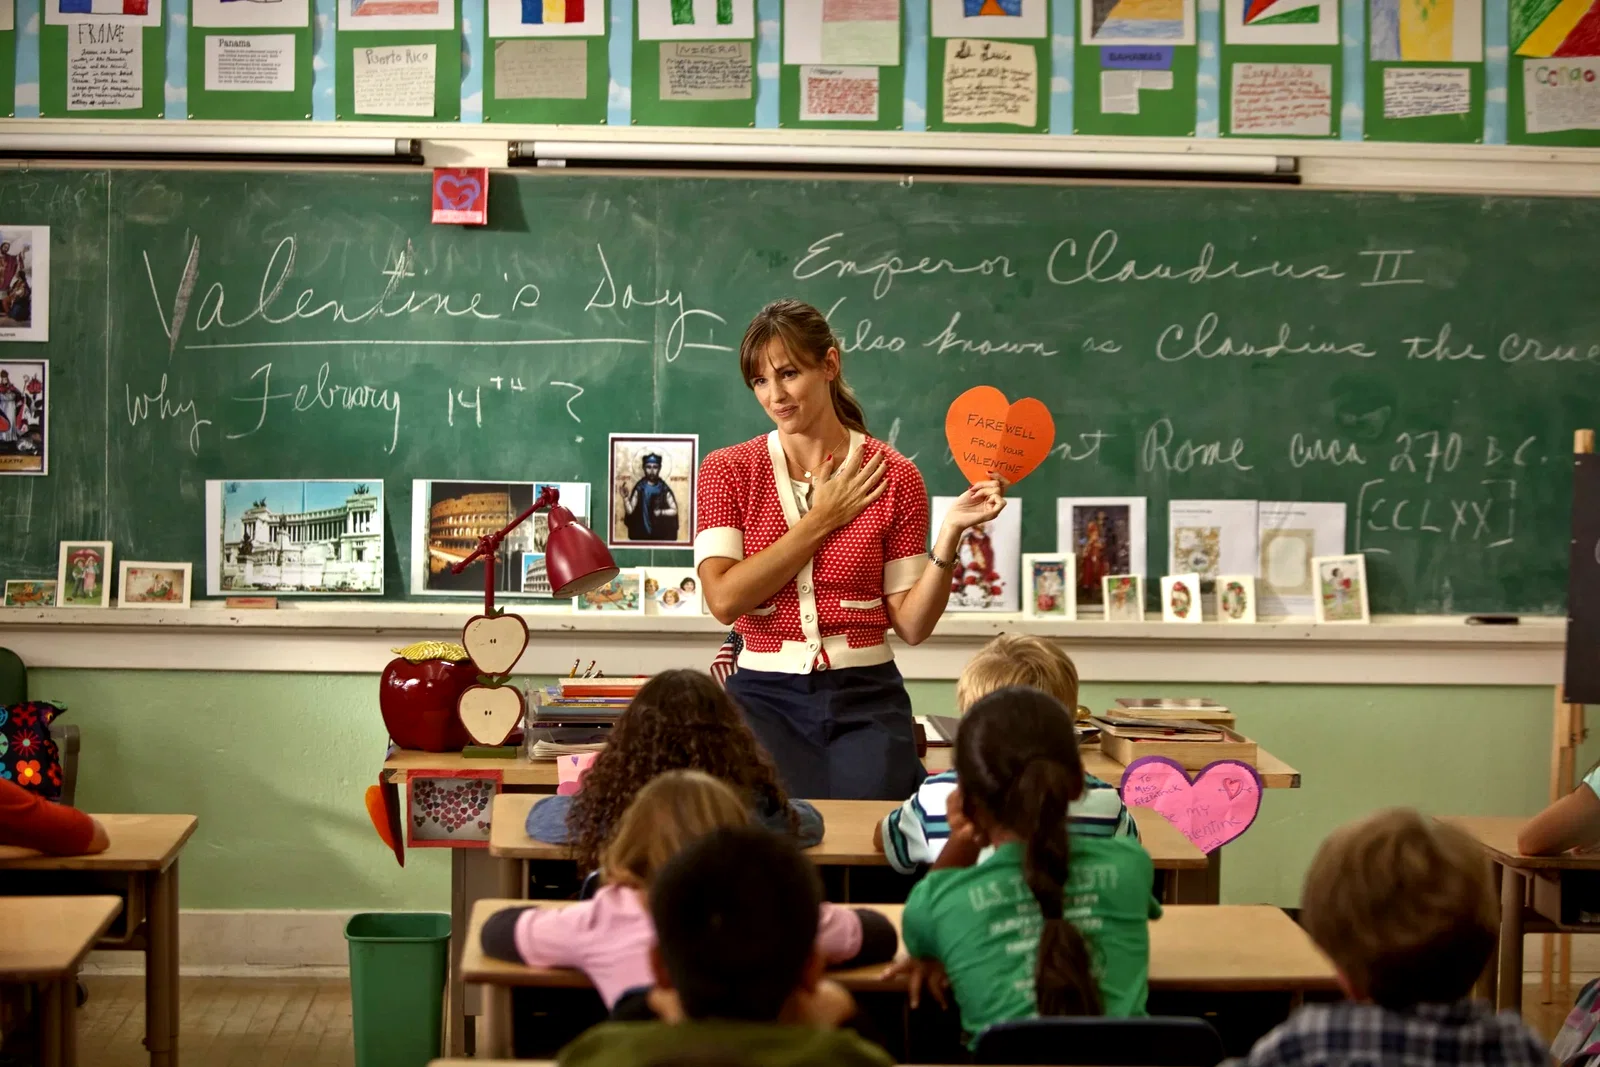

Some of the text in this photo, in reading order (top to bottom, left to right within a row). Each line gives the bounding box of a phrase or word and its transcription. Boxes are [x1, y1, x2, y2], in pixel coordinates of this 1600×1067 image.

[218, 38, 251, 48] Panama
[405, 47, 428, 64] Rico
[1534, 65, 1597, 88] Congo
[793, 229, 1425, 300] Emperor Claudius II
[584, 242, 727, 362] Day
[922, 311, 1060, 357] known
[1082, 335, 1123, 354] as
[1156, 312, 1377, 362] Claudius
[1401, 322, 1487, 361] the
[967, 413, 1036, 440] FAREWELL
[970, 437, 1025, 457] FROM YOUR
[1141, 418, 1254, 473] Rome
[1389, 431, 1462, 484] 270
[962, 451, 1025, 475] VALENTINE
